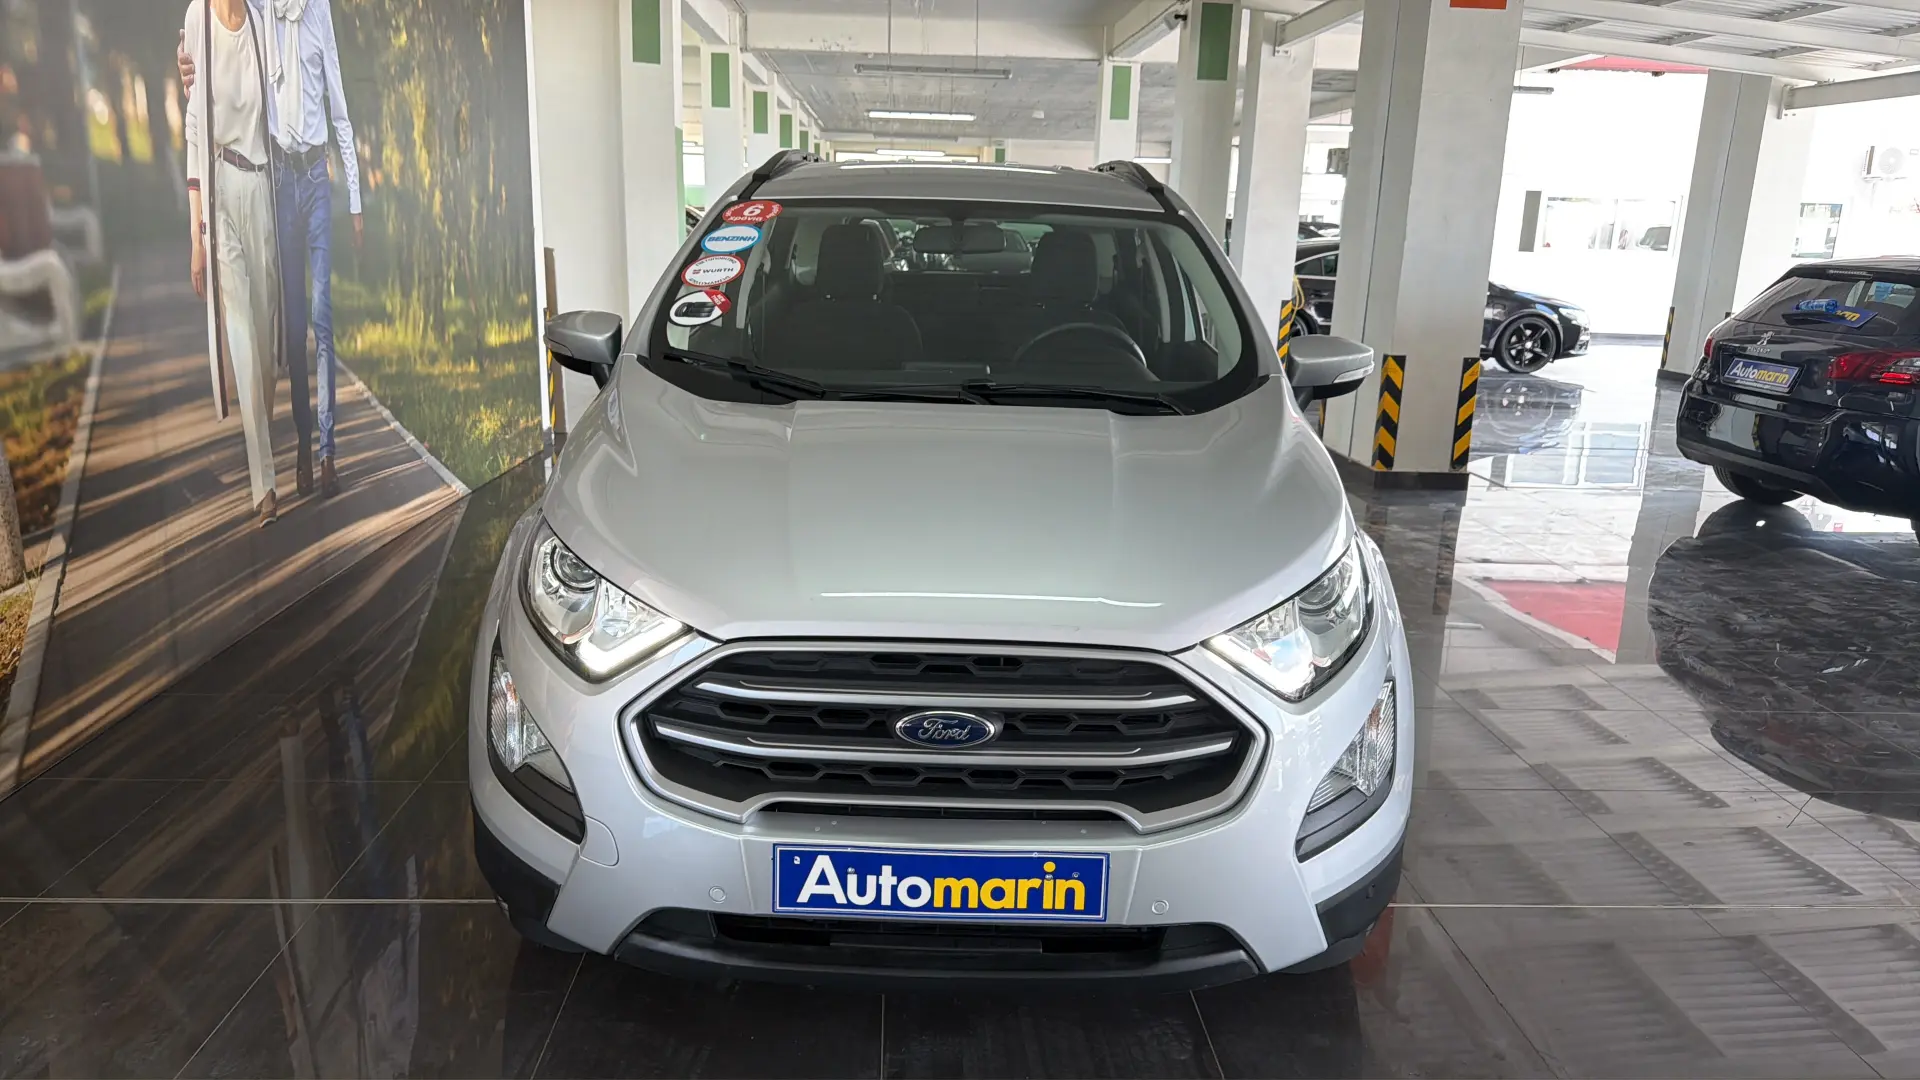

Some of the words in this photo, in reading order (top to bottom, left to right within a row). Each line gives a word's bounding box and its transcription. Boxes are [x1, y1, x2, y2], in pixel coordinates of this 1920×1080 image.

[1729, 361, 1789, 384] Automarin
[918, 718, 972, 740] Ford
[796, 854, 1086, 911] Automarin
